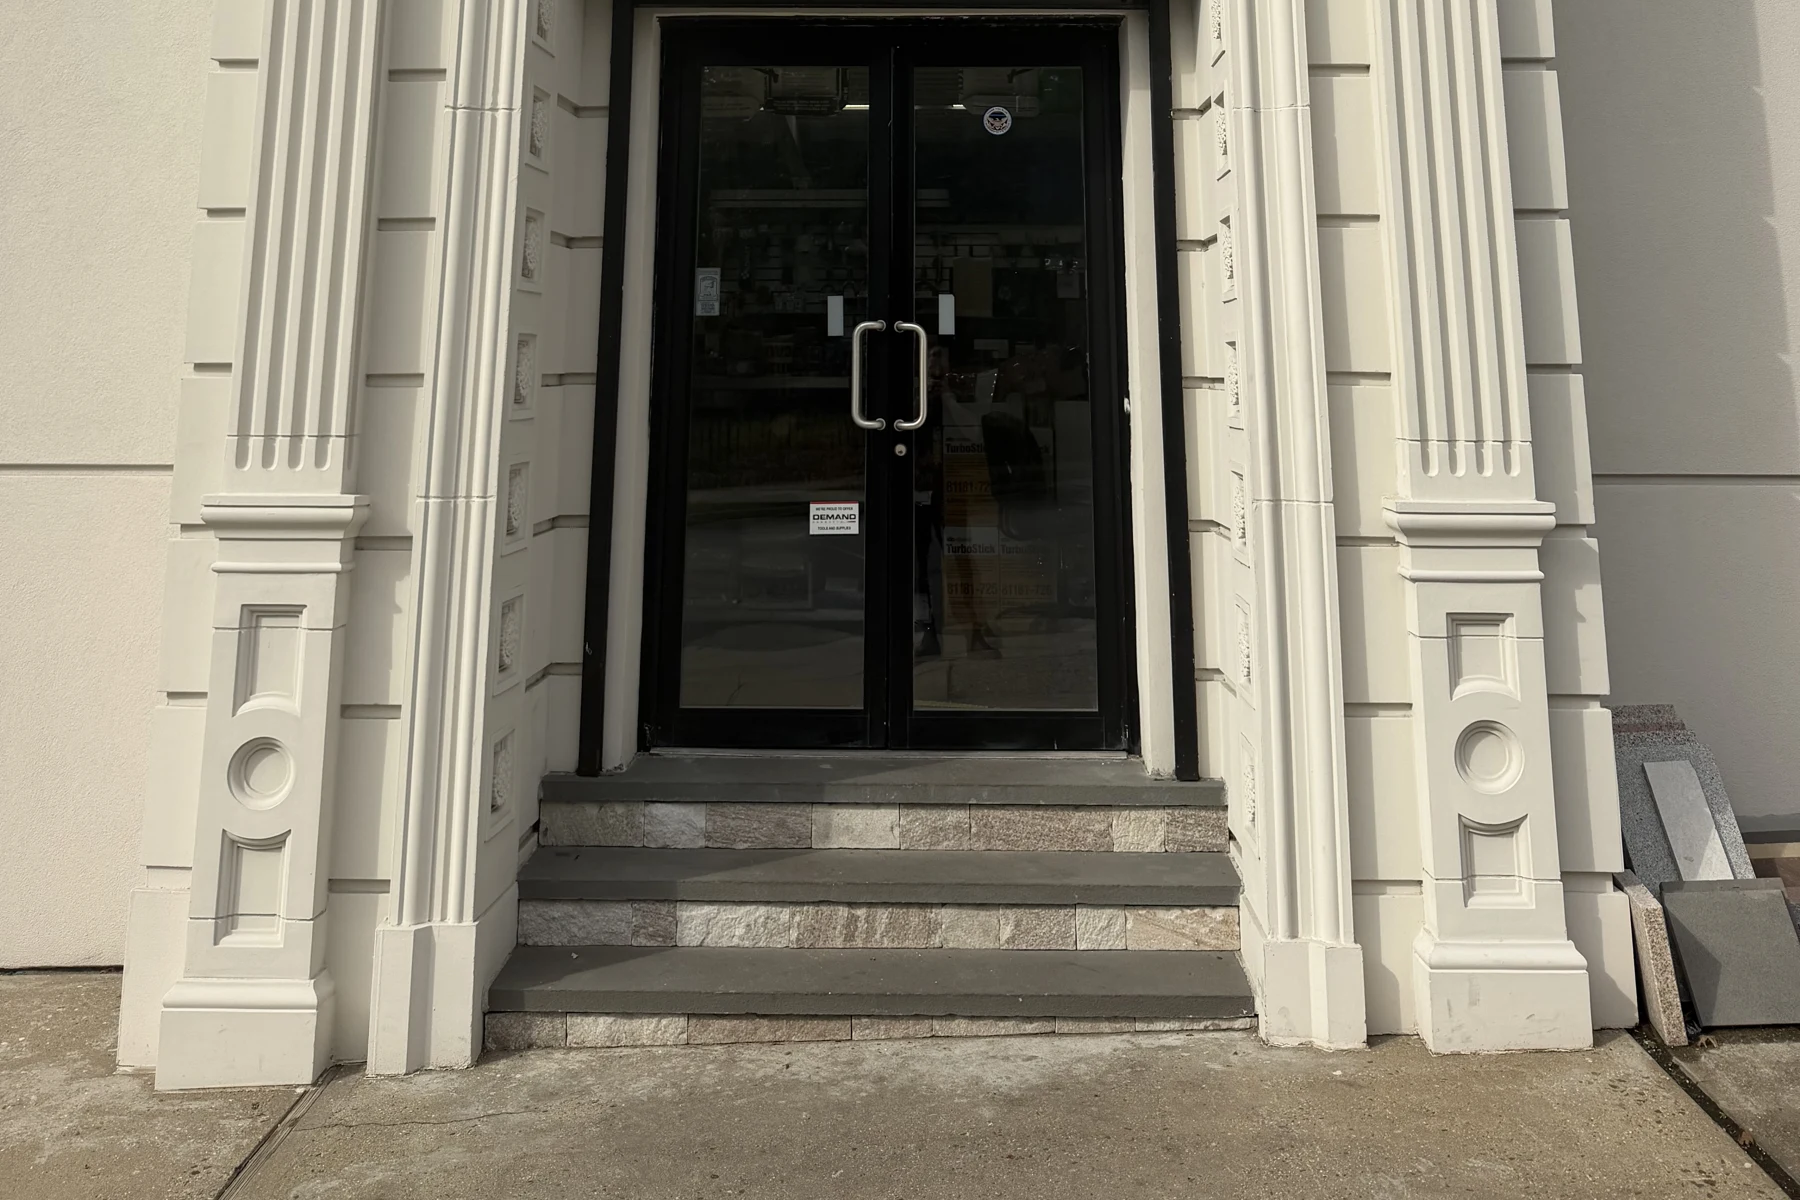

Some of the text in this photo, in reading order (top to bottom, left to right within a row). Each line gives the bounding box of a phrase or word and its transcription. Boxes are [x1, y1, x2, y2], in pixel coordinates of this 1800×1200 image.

[945, 442, 985, 453] TurboSti
[946, 480, 991, 493] 81181-72
[946, 543, 995, 554] TurboStick
